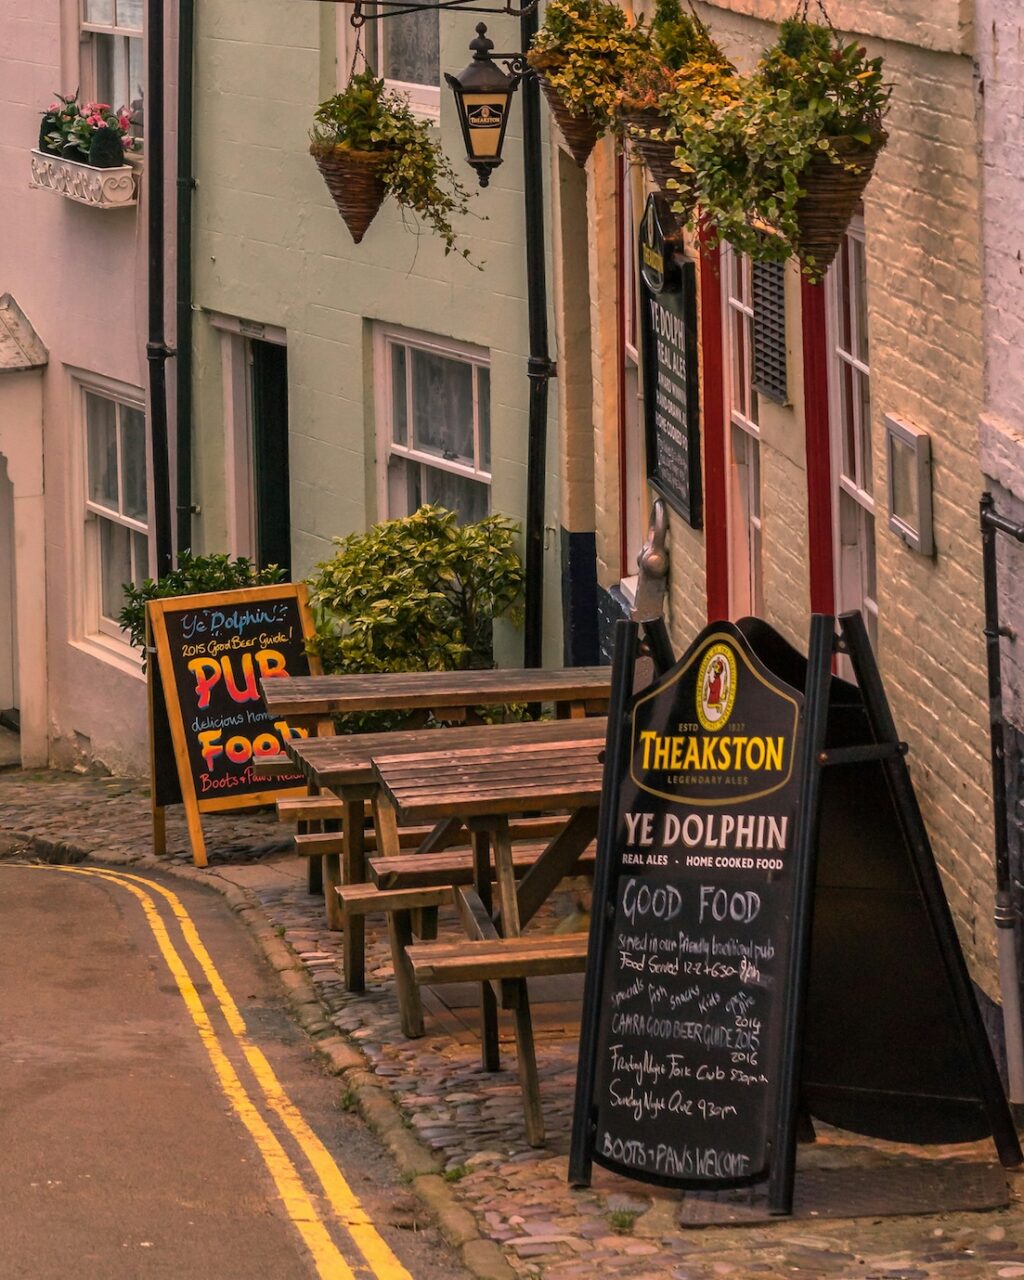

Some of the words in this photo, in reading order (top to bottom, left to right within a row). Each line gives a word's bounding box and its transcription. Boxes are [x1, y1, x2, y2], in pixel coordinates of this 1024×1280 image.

[650, 298, 660, 333] YE
[660, 305, 686, 353] DOLPH
[180, 613, 207, 639] Ye
[182, 643, 206, 657] 2015
[207, 640, 231, 656] Good
[231, 635, 257, 649] Beer
[187, 649, 290, 710] PUB
[191, 713, 244, 732] delicious
[678, 723, 698, 732] ESTD
[728, 723, 745, 732] 1827
[640, 730, 785, 771] THEAKSTON
[199, 772, 239, 793] Boots
[667, 775, 722, 784] LEGENDARY
[725, 776, 749, 784] ALES
[625, 812, 655, 847] YE
[662, 813, 788, 851] DOLPHIN
[622, 853, 644, 865] REAL
[646, 854, 668, 866] ALES
[686, 856, 713, 867] HOME
[715, 856, 754, 869] COOKED
[756, 858, 783, 870] FOOD
[623, 878, 683, 926] GOOD
[699, 884, 761, 924] FOOD
[619, 950, 646, 971] Food
[649, 934, 658, 953] in
[659, 938, 677, 952] our
[754, 938, 775, 966] pub
[611, 1012, 645, 1036] CAMRA
[646, 1016, 671, 1039] GOOD
[672, 1020, 703, 1044] BEER
[703, 1023, 734, 1051] GUIDE
[734, 1028, 761, 1051] 2015
[731, 1052, 759, 1066] 2016
[609, 1078, 643, 1121] Sunday
[601, 1131, 647, 1166] BOOTS
[656, 1143, 694, 1175] PAWS
[695, 1147, 751, 1178] WELCOME
